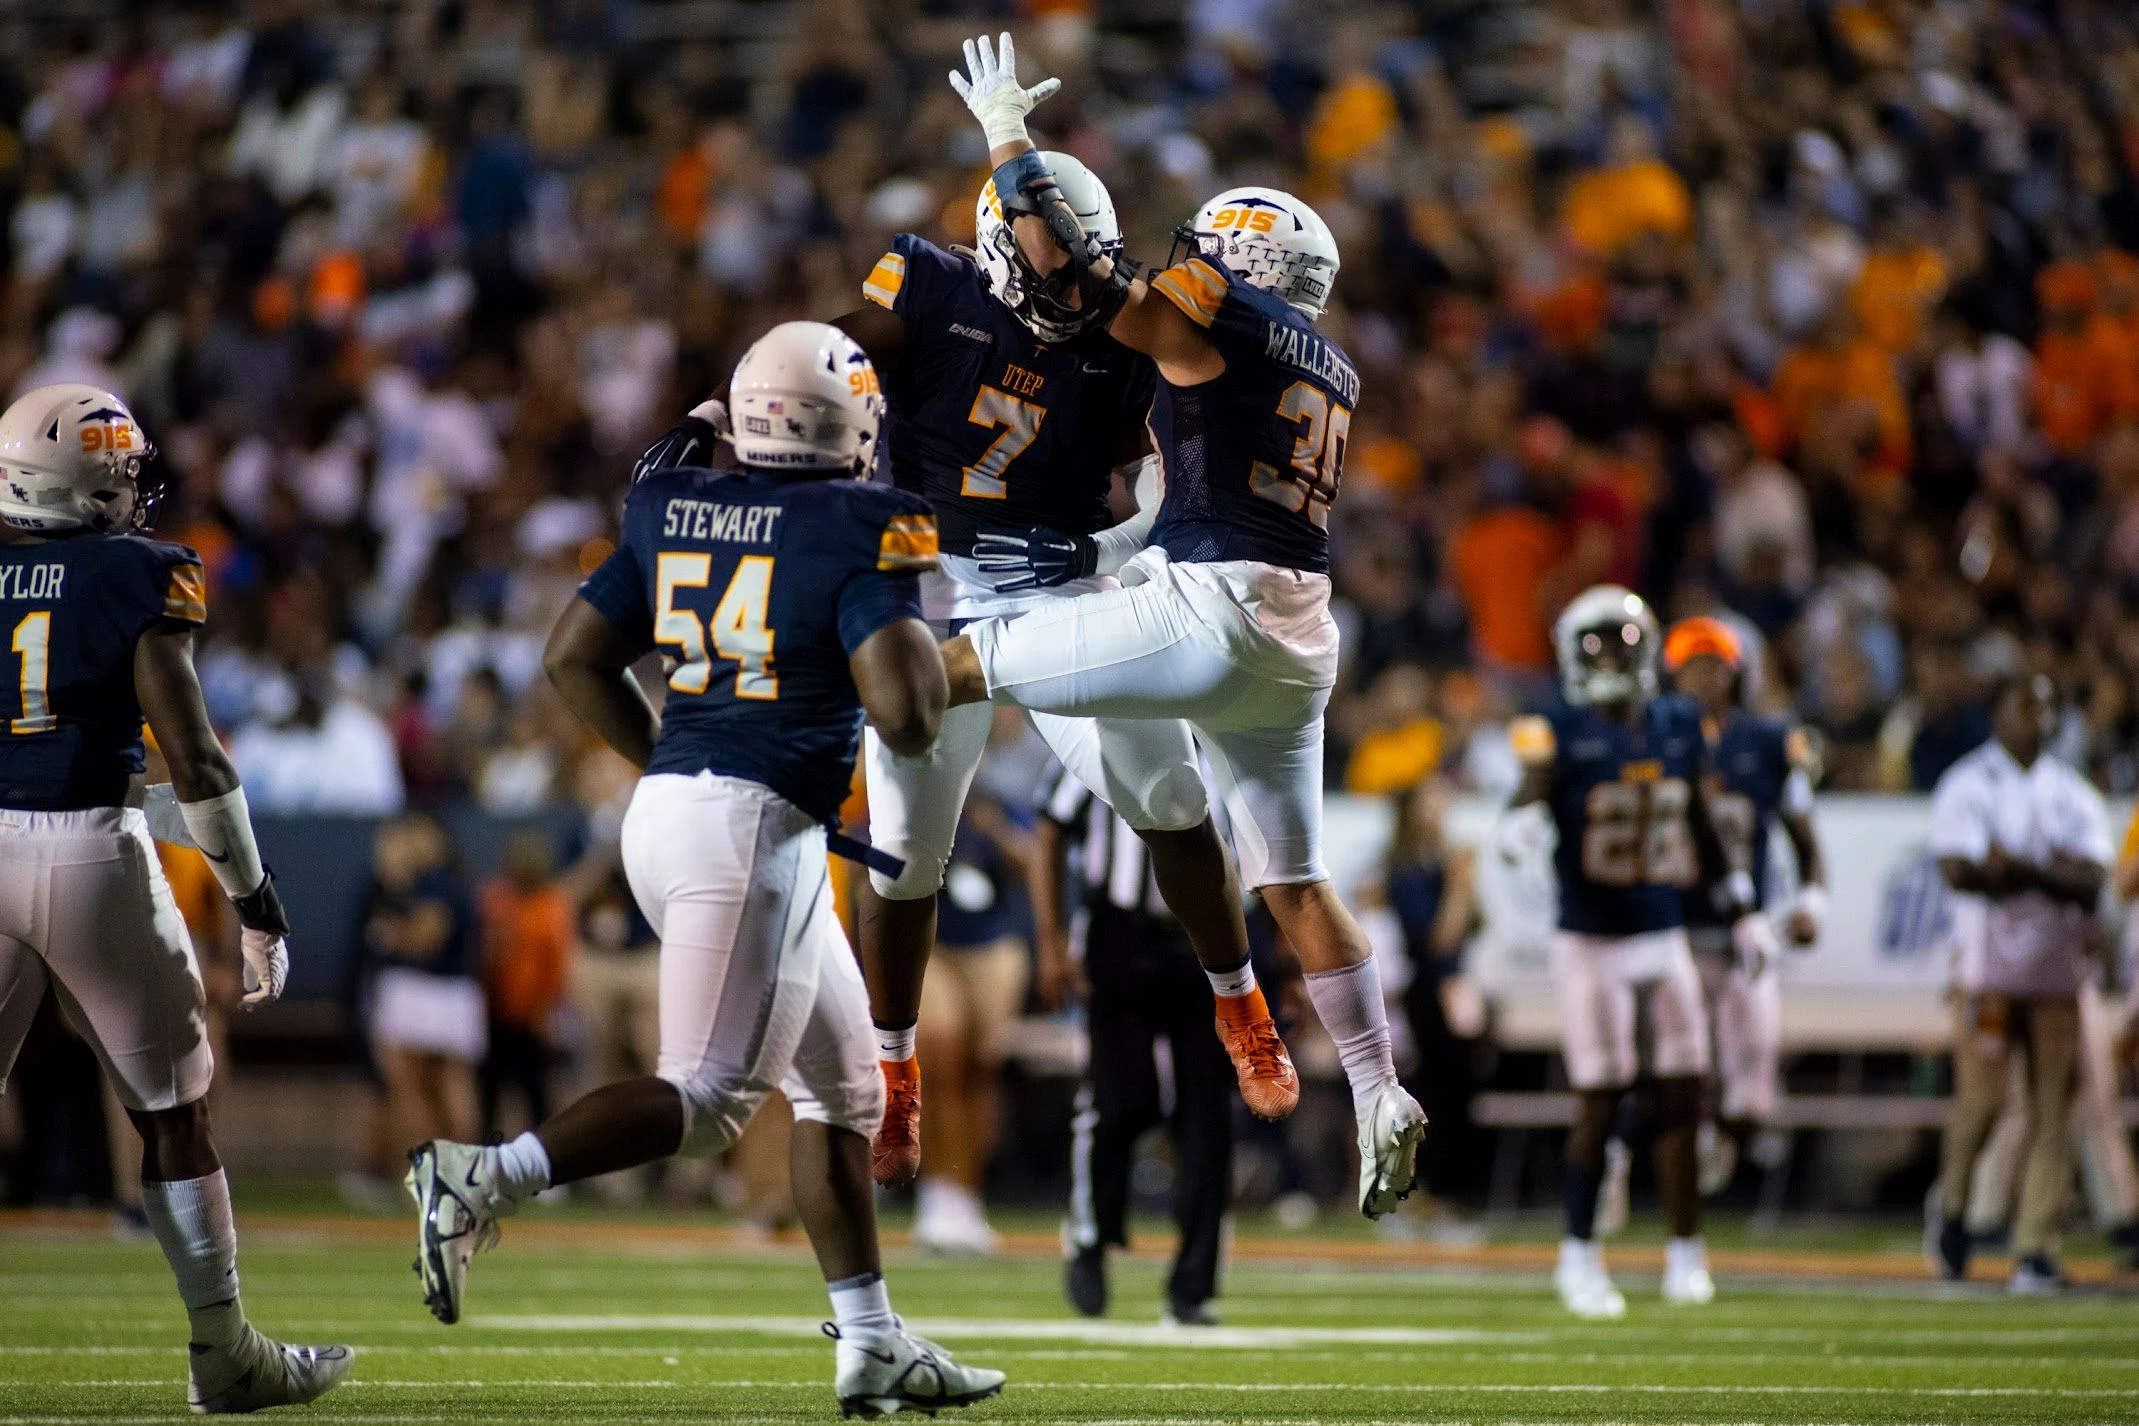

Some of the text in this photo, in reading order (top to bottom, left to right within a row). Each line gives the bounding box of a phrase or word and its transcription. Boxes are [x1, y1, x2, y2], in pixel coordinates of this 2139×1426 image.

[1212, 208, 1278, 233] 915
[847, 367, 879, 396] 915
[1001, 363, 1044, 397] UTEP
[80, 425, 132, 452] 915
[960, 383, 1047, 499] 7
[746, 451, 818, 463] MINERS
[1249, 379, 1351, 535] 30
[663, 498, 782, 543] STEWART
[654, 551, 779, 700] 54
